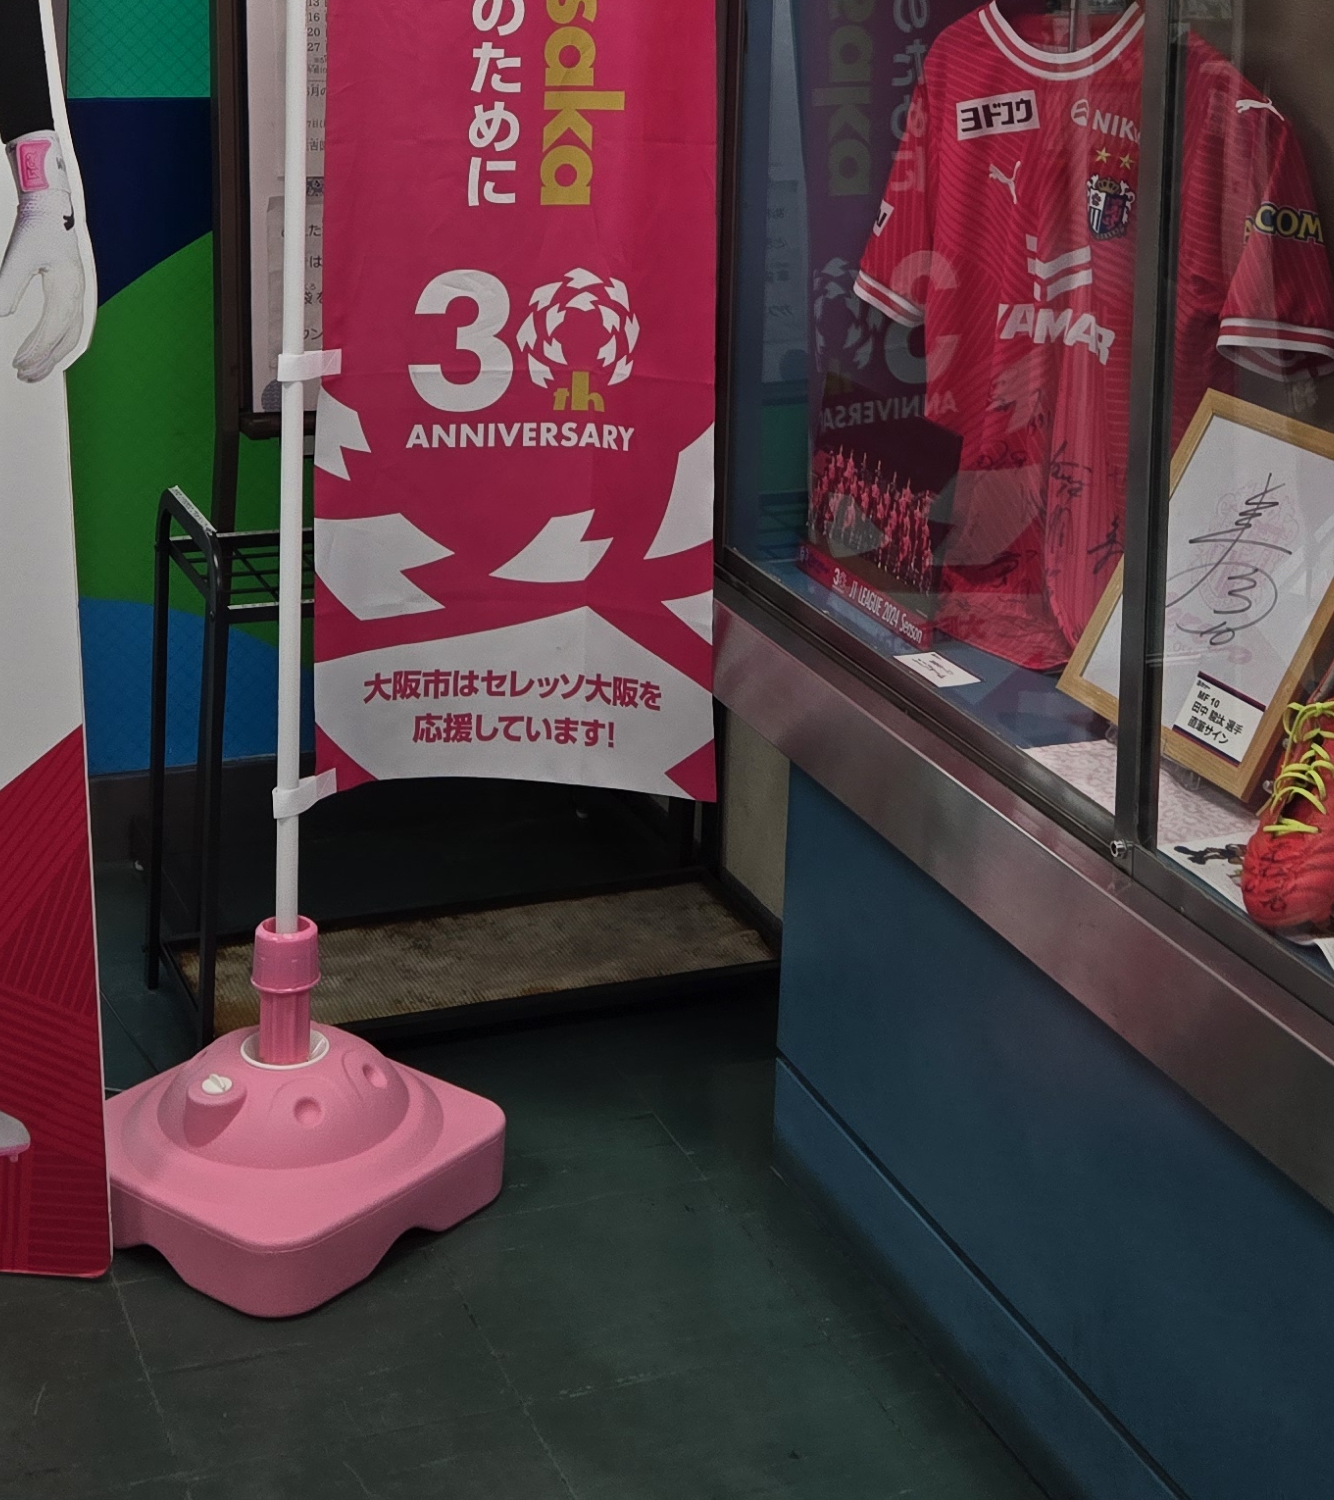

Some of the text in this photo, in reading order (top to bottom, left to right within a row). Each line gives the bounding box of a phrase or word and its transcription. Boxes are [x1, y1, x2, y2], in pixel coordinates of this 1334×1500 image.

[960, 98, 1033, 132] ヨドコウ
[406, 422, 635, 452] ANNIVERSARY
[363, 669, 662, 712] 大阪市はセレッソ大阪を
[1197, 690, 1220, 708] MF 10
[1191, 701, 1209, 716] 田中
[413, 713, 616, 748] 応援しています！
[1187, 715, 1229, 744] 直筆サイン
